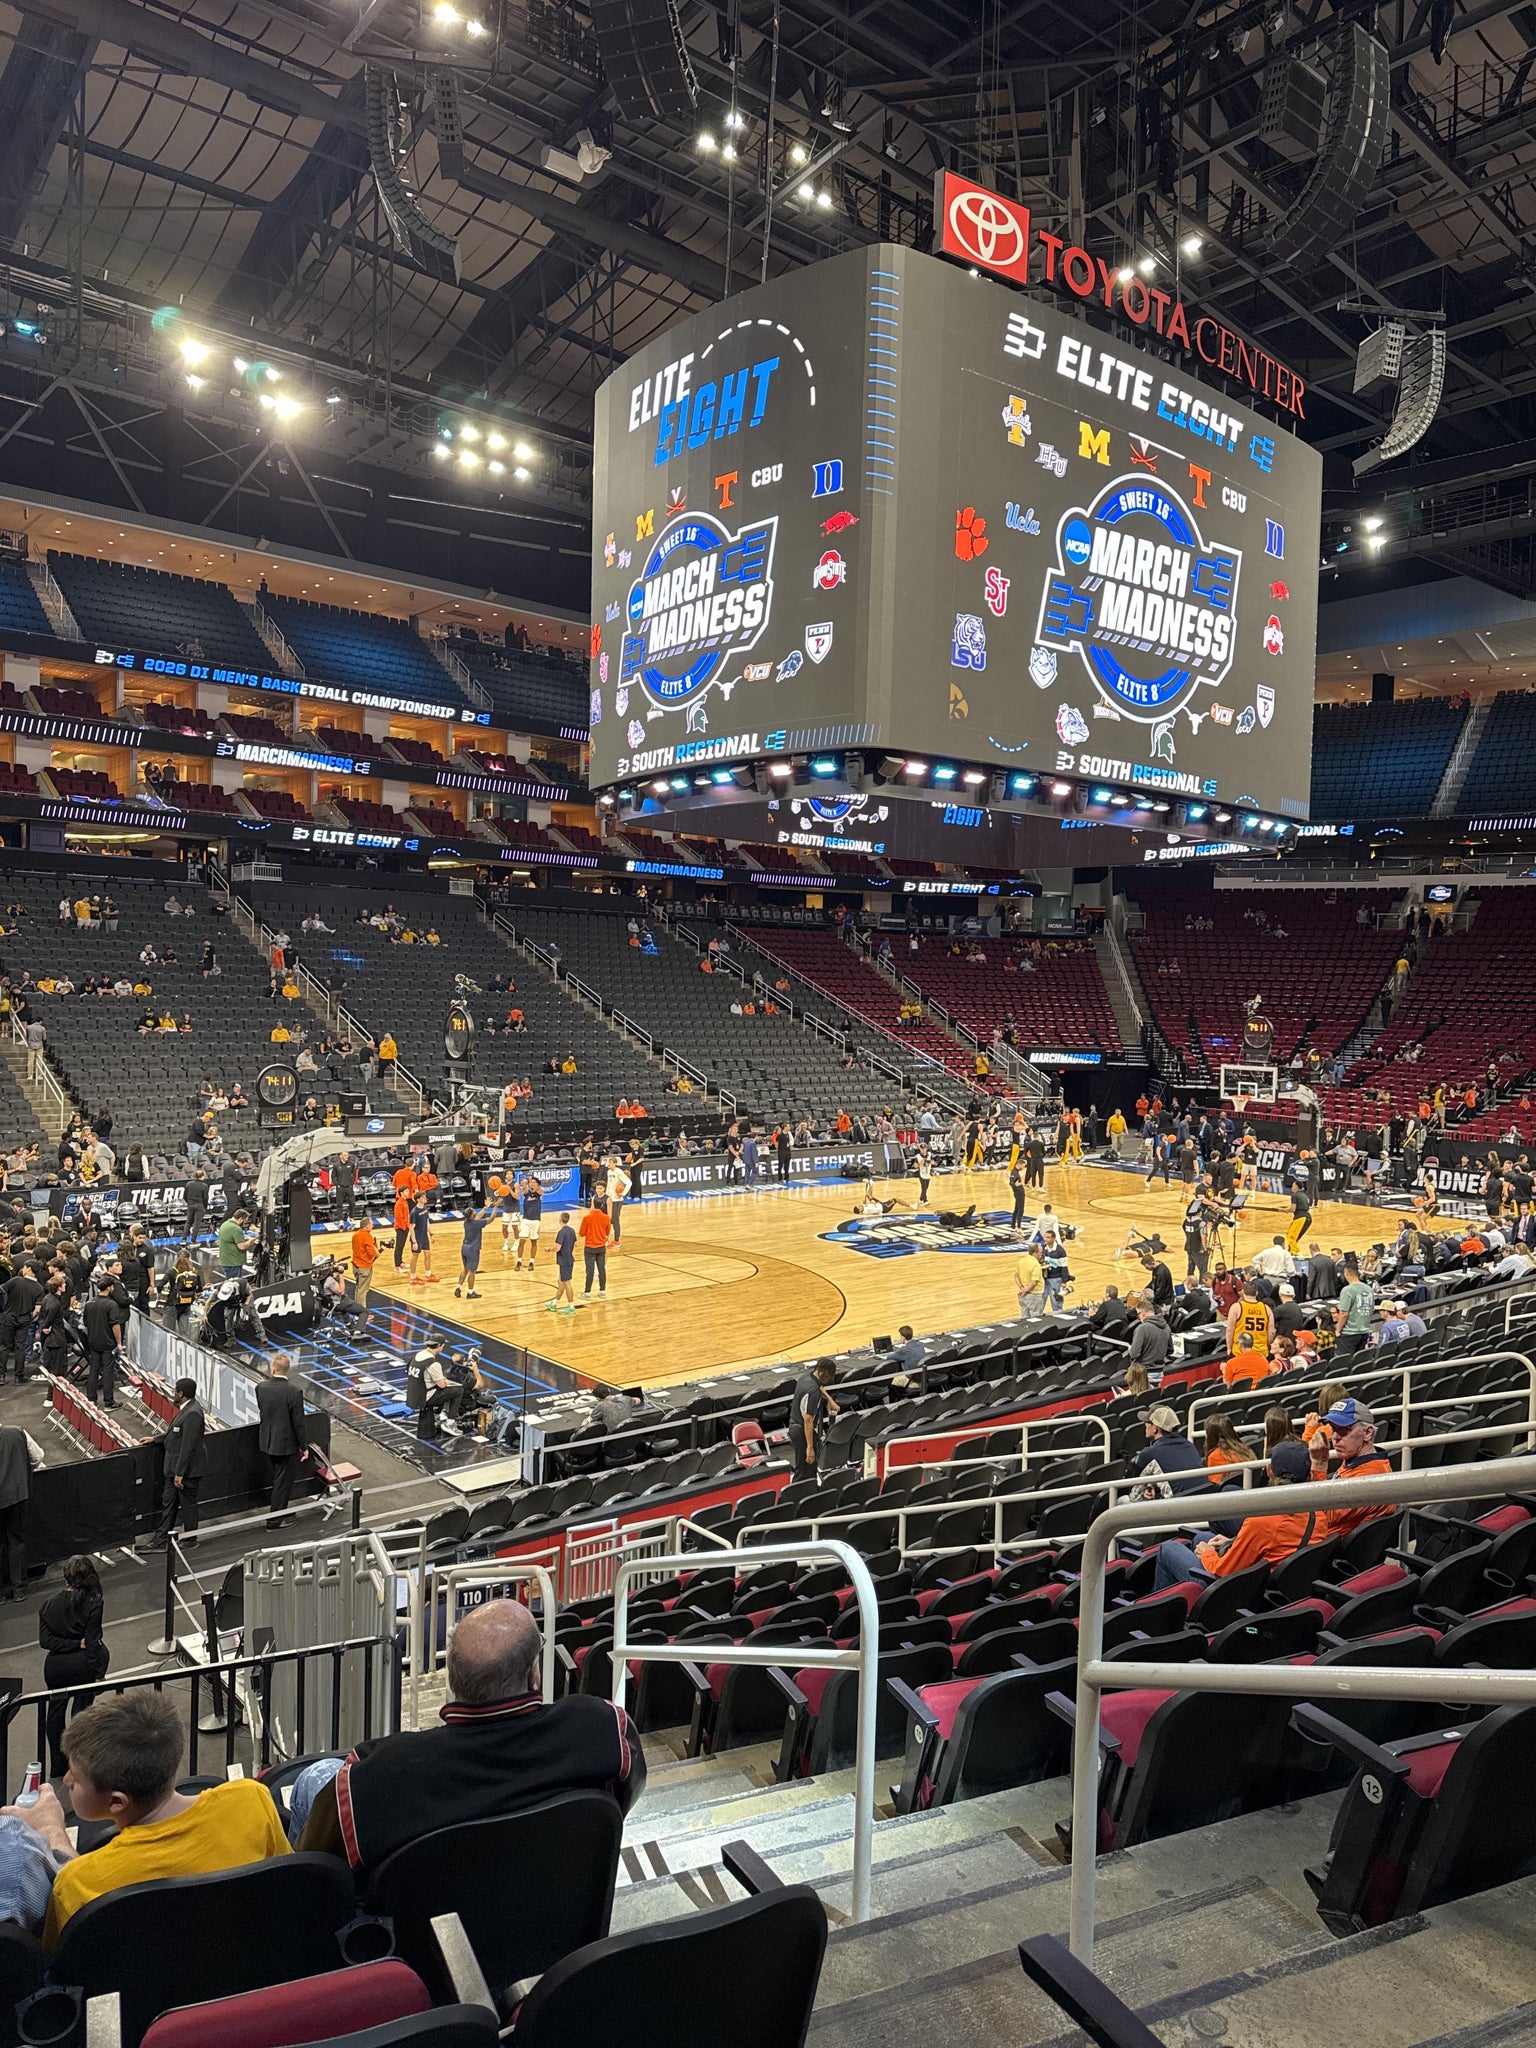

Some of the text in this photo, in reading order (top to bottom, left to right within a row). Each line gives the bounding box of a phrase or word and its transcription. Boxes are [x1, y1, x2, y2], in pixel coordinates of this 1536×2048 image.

[1036, 230, 1306, 420] TOYOTA CENTER
[628, 352, 695, 433] ELITE
[1056, 335, 1244, 453] ELITE EIGHT
[654, 356, 780, 468] EIGHT
[1078, 421, 1111, 467] M
[1035, 441, 1069, 478] HPU
[714, 470, 739, 510] T
[751, 463, 784, 488] CBU
[1188, 462, 1211, 509] T
[1118, 490, 1171, 520] SWEET 16
[1221, 485, 1247, 514] CBU
[636, 509, 655, 542] M
[659, 528, 685, 559] SWEET
[685, 527, 697, 542] 16
[1066, 537, 1091, 555] NCAA
[1089, 525, 1191, 598] MARCH
[643, 552, 718, 620] MARCH
[648, 583, 766, 655] MADNESS
[1098, 581, 1232, 661] MADNESS
[660, 674, 692, 696] ELITE 8
[749, 664, 771, 680] VCU
[1116, 672, 1160, 702] ELITE 8
[143, 657, 456, 719] 2026 DI MEN'S BASKETBALL CHAMPIONSHIP
[235, 743, 354, 774] MARCHMADNESS
[631, 733, 761, 774] SOUTH REGIONAL
[1079, 754, 1202, 794] SOUTH REGIONAL
[943, 807, 984, 828] EIGHT
[312, 829, 401, 849] ELITE EIGHT
[791, 832, 873, 853] SOUTH REGIONAL
[1159, 843, 1250, 860] SOUTH REGIONAL
[625, 860, 725, 880] #MARCHMADNESS
[918, 882, 986, 895] ELITE EIGHT
[1029, 1052, 1102, 1065] MARCHMADNESS
[265, 1075, 292, 1087] 74:11
[533, 1168, 571, 1181] MADNESS
[640, 1165, 711, 1187] WELCOME
[770, 1157, 811, 1175] EITE
[813, 1154, 855, 1171] EIGHT
[131, 1189, 162, 1206] THE
[1245, 1316, 1265, 1332] 55
[463, 1590, 482, 1605] 110
[1366, 1781, 1380, 1799] 12
